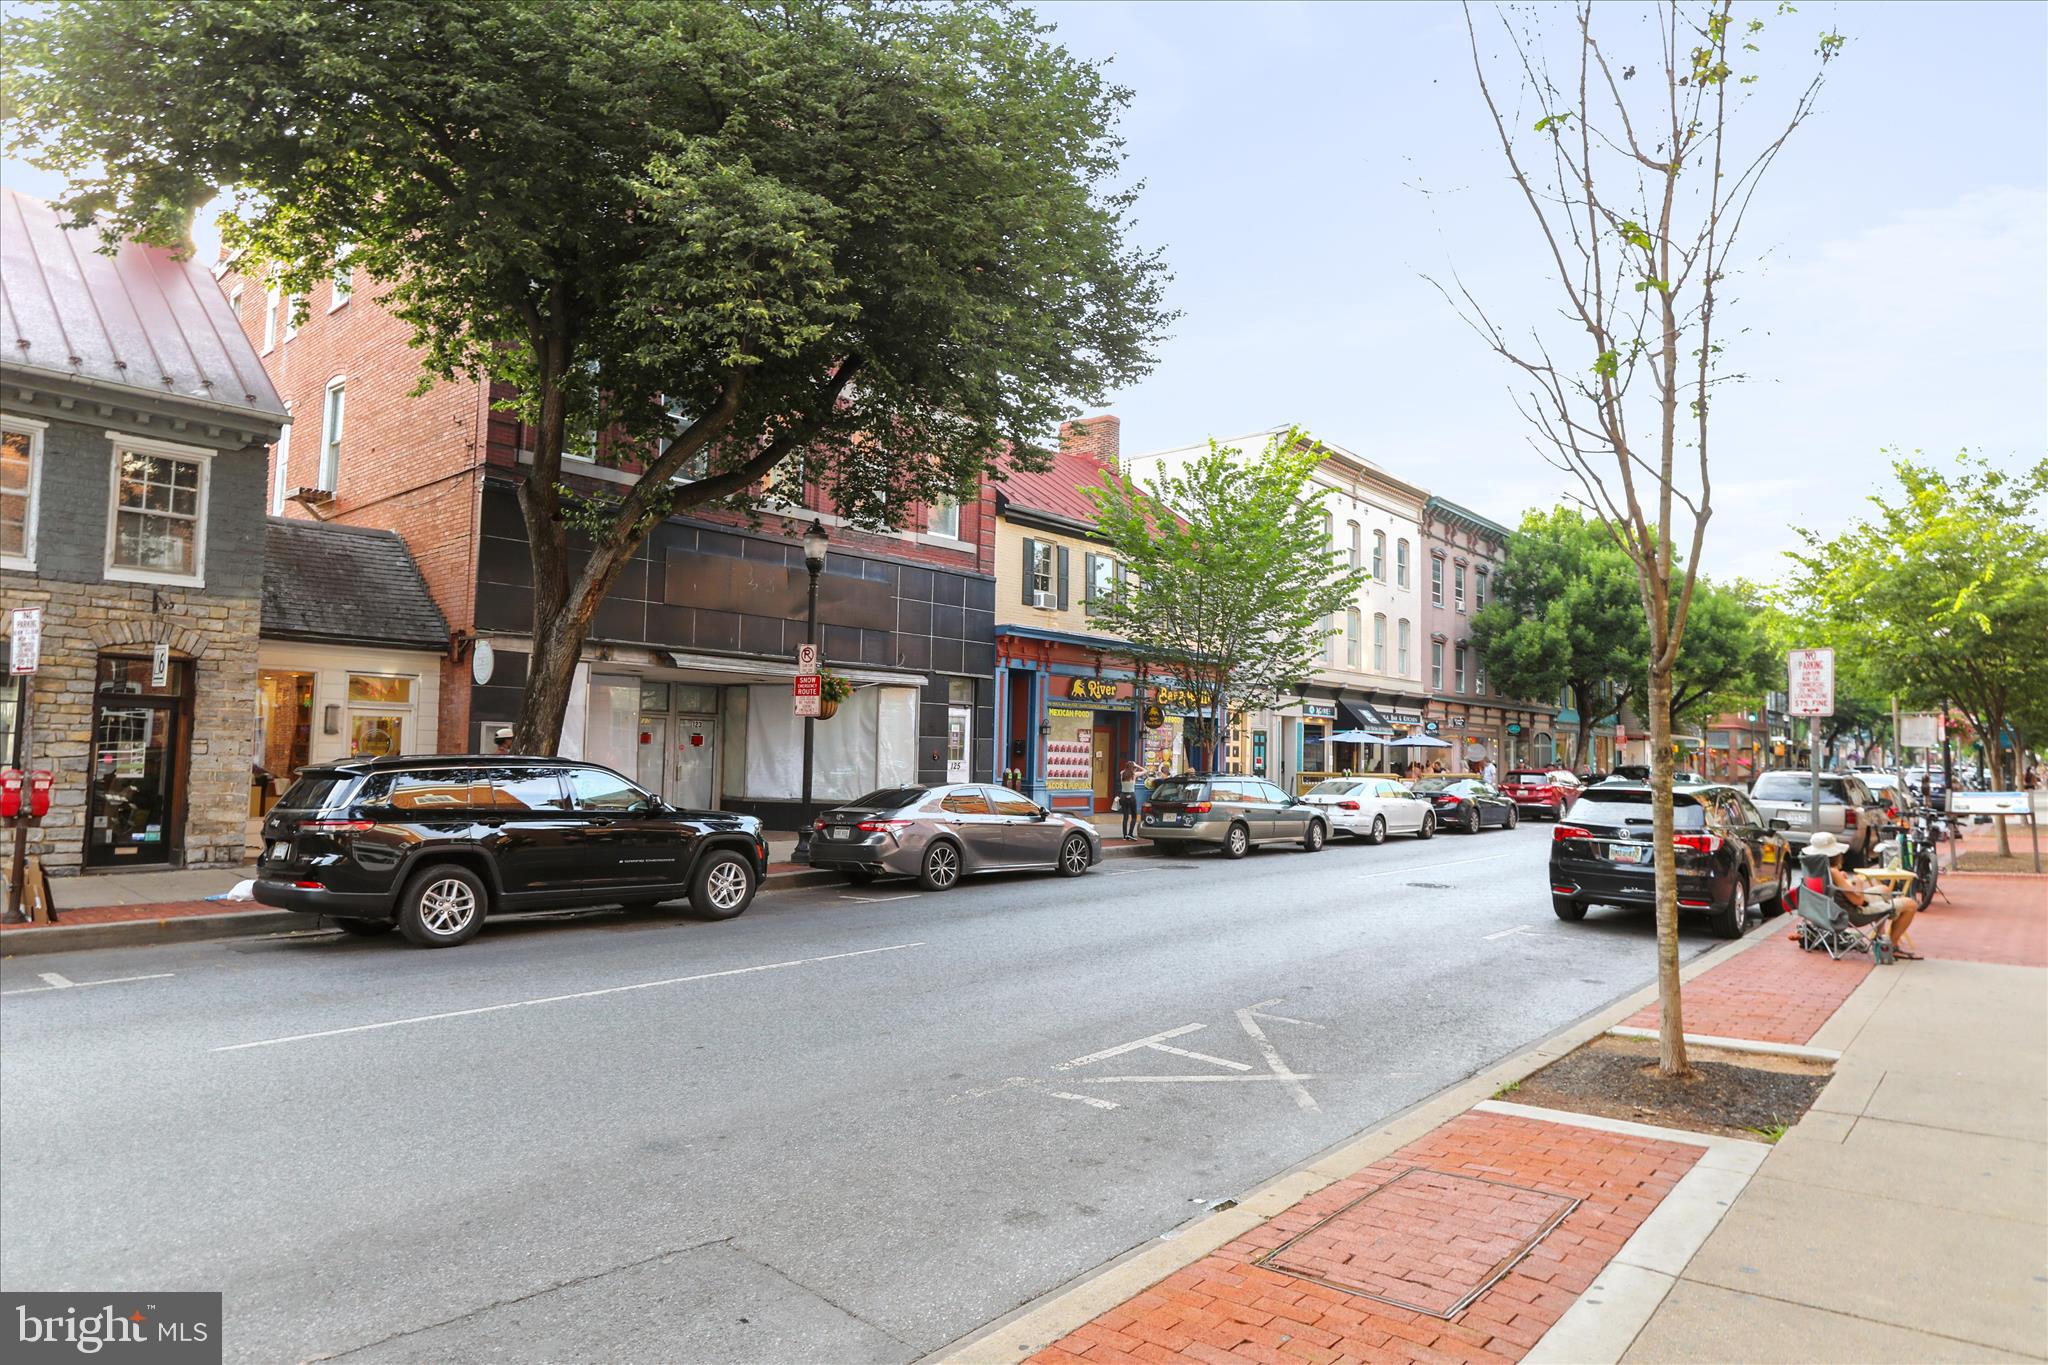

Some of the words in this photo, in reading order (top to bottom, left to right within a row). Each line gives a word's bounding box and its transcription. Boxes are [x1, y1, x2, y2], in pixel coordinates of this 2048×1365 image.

[1805, 651, 1816, 660] NO
[1798, 661, 1823, 669] PARKING
[1087, 680, 1117, 699] River
[1049, 709, 1074, 717] MEXICAN
[951, 762, 960, 770] 125
